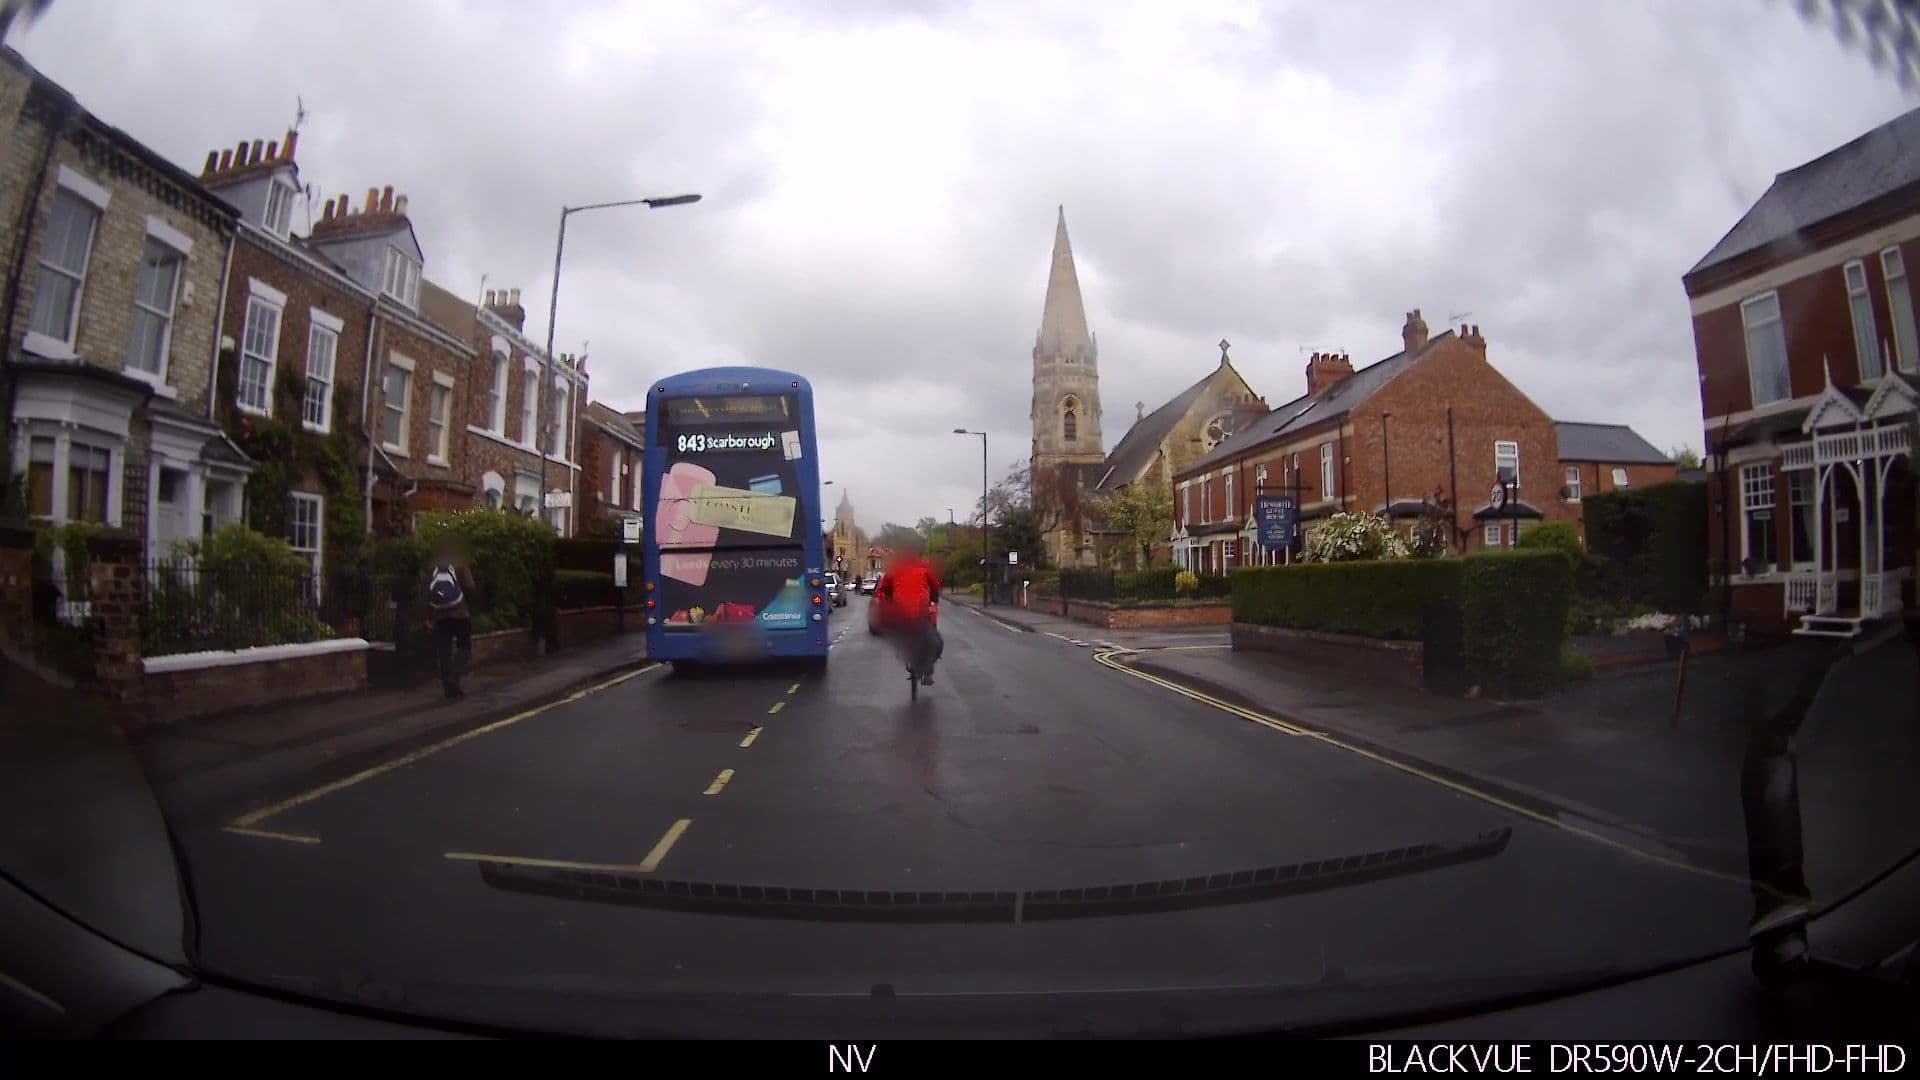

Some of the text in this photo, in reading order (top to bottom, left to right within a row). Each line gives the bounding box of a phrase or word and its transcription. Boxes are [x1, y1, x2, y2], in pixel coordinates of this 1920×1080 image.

[678, 432, 775, 452] 843 Scarborough
[1492, 490, 1502, 503] 20
[711, 559, 739, 570] every
[742, 558, 755, 568] 30
[756, 557, 798, 568] minutes
